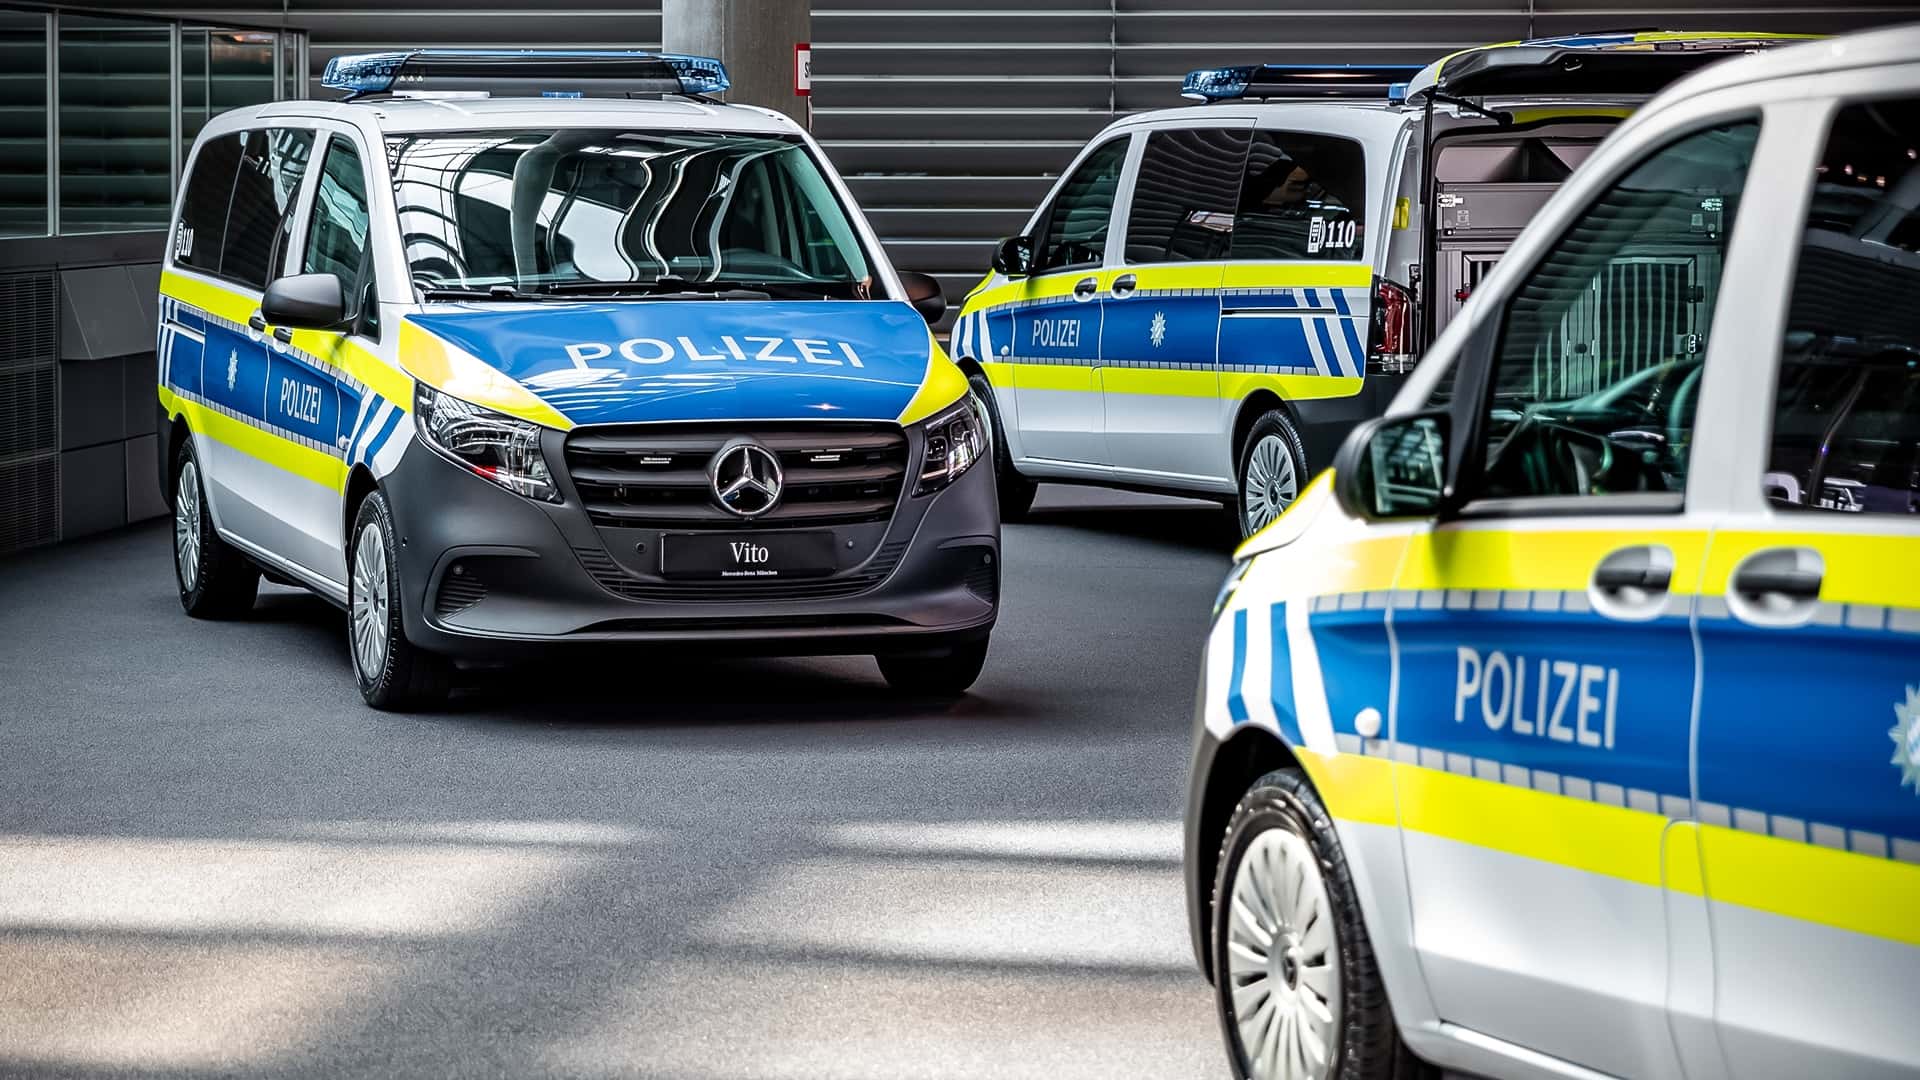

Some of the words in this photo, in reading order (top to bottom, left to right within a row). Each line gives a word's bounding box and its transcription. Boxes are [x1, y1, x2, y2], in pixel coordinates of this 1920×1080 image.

[1325, 220, 1356, 248] 110
[1032, 319, 1080, 347] POLIZEI
[566, 335, 863, 371] POLIZEI
[280, 376, 321, 425] POLIZEI
[729, 542, 769, 563] Vito
[1454, 646, 1620, 749] POLIZEI
